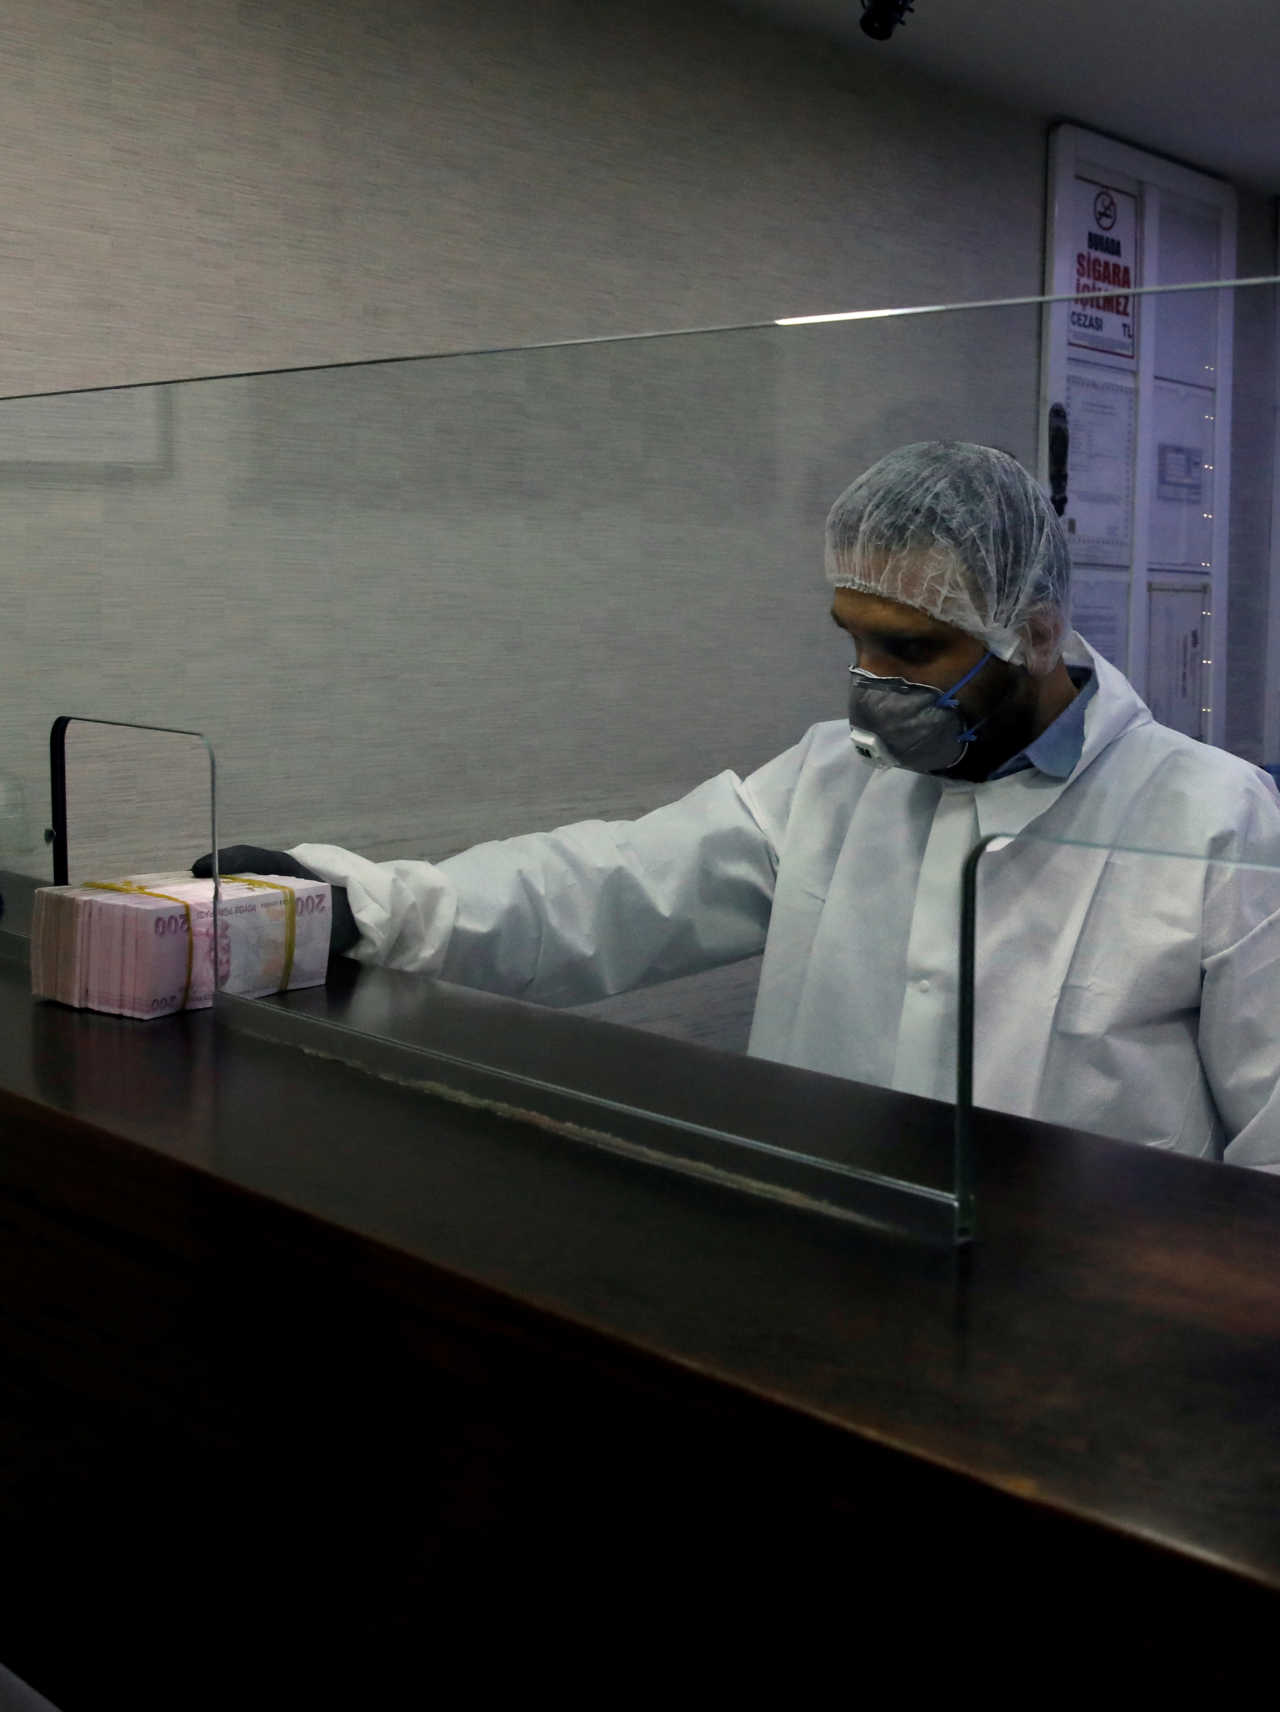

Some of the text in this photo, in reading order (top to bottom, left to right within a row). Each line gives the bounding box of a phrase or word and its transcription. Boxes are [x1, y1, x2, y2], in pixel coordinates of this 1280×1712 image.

[1087, 231, 1122, 258] BURADA
[1076, 251, 1131, 289] SİGARA
[1070, 311, 1103, 332] CEZASI
